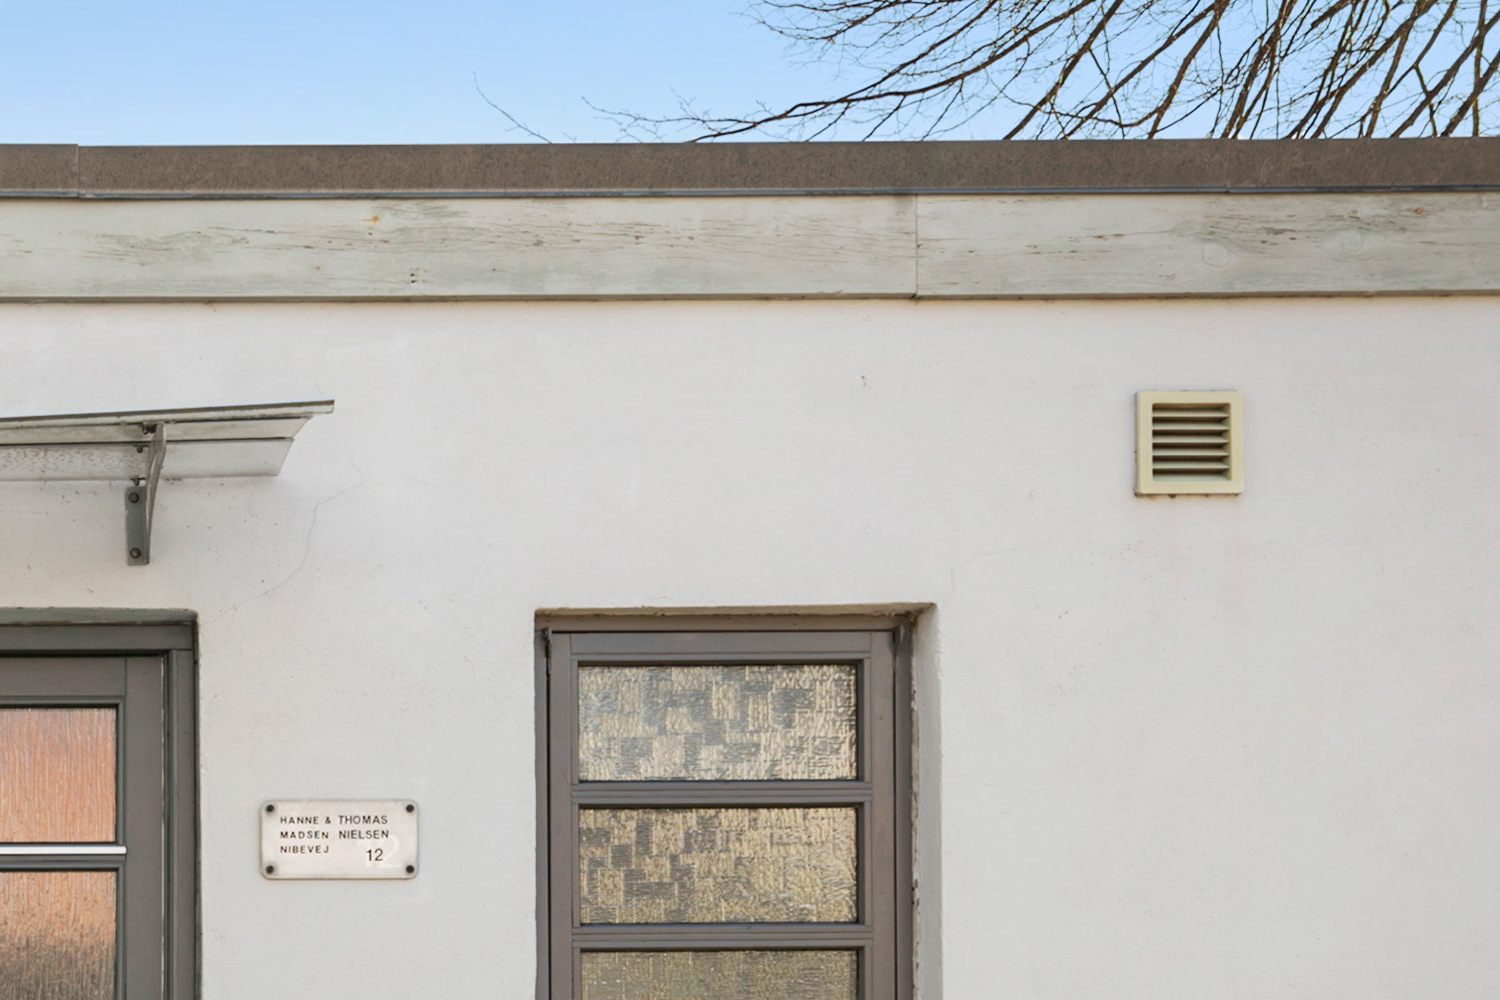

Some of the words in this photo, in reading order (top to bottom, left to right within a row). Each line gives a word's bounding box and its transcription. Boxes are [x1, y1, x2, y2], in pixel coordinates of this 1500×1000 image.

[280, 816, 319, 825] HANNE
[325, 816, 331, 825] &
[338, 815, 388, 825] THOMAS
[280, 831, 329, 839] MADSEN
[339, 830, 389, 839] NIELSEN
[280, 845, 329, 853] NIBEVEJ
[366, 848, 383, 861] 12
